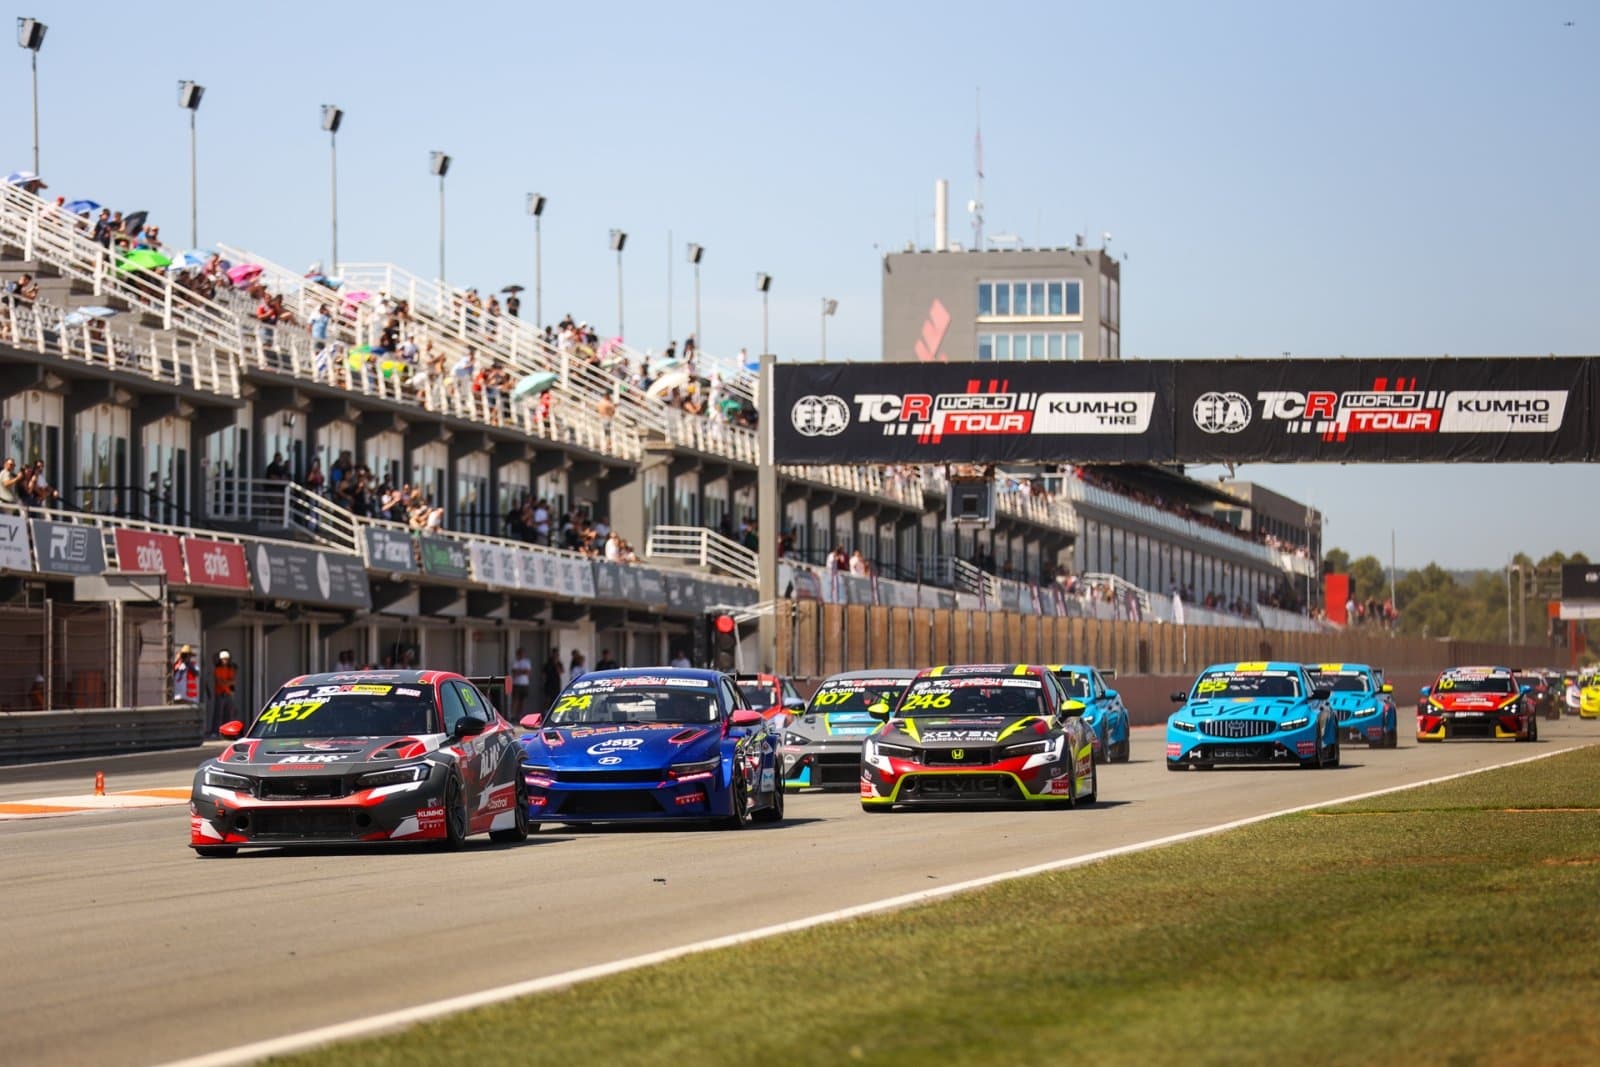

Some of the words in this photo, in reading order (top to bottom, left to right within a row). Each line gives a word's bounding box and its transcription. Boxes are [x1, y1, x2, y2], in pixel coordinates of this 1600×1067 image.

[854, 393, 933, 422] TCR
[940, 396, 1008, 410] WORLD
[1048, 400, 1138, 414] KUMHO
[1257, 391, 1338, 419] TCR
[1344, 393, 1418, 407] WORLD
[1456, 399, 1550, 413] KUMHO
[949, 413, 1026, 431] TOUR
[1096, 415, 1137, 426] TIRE
[1354, 412, 1433, 430] TOUR
[1506, 413, 1549, 424] TIRE
[553, 695, 593, 714] 24
[814, 692, 854, 707] 107
[900, 692, 951, 712] 246
[258, 702, 325, 724] 437
[417, 808, 445, 818] KUMHO
